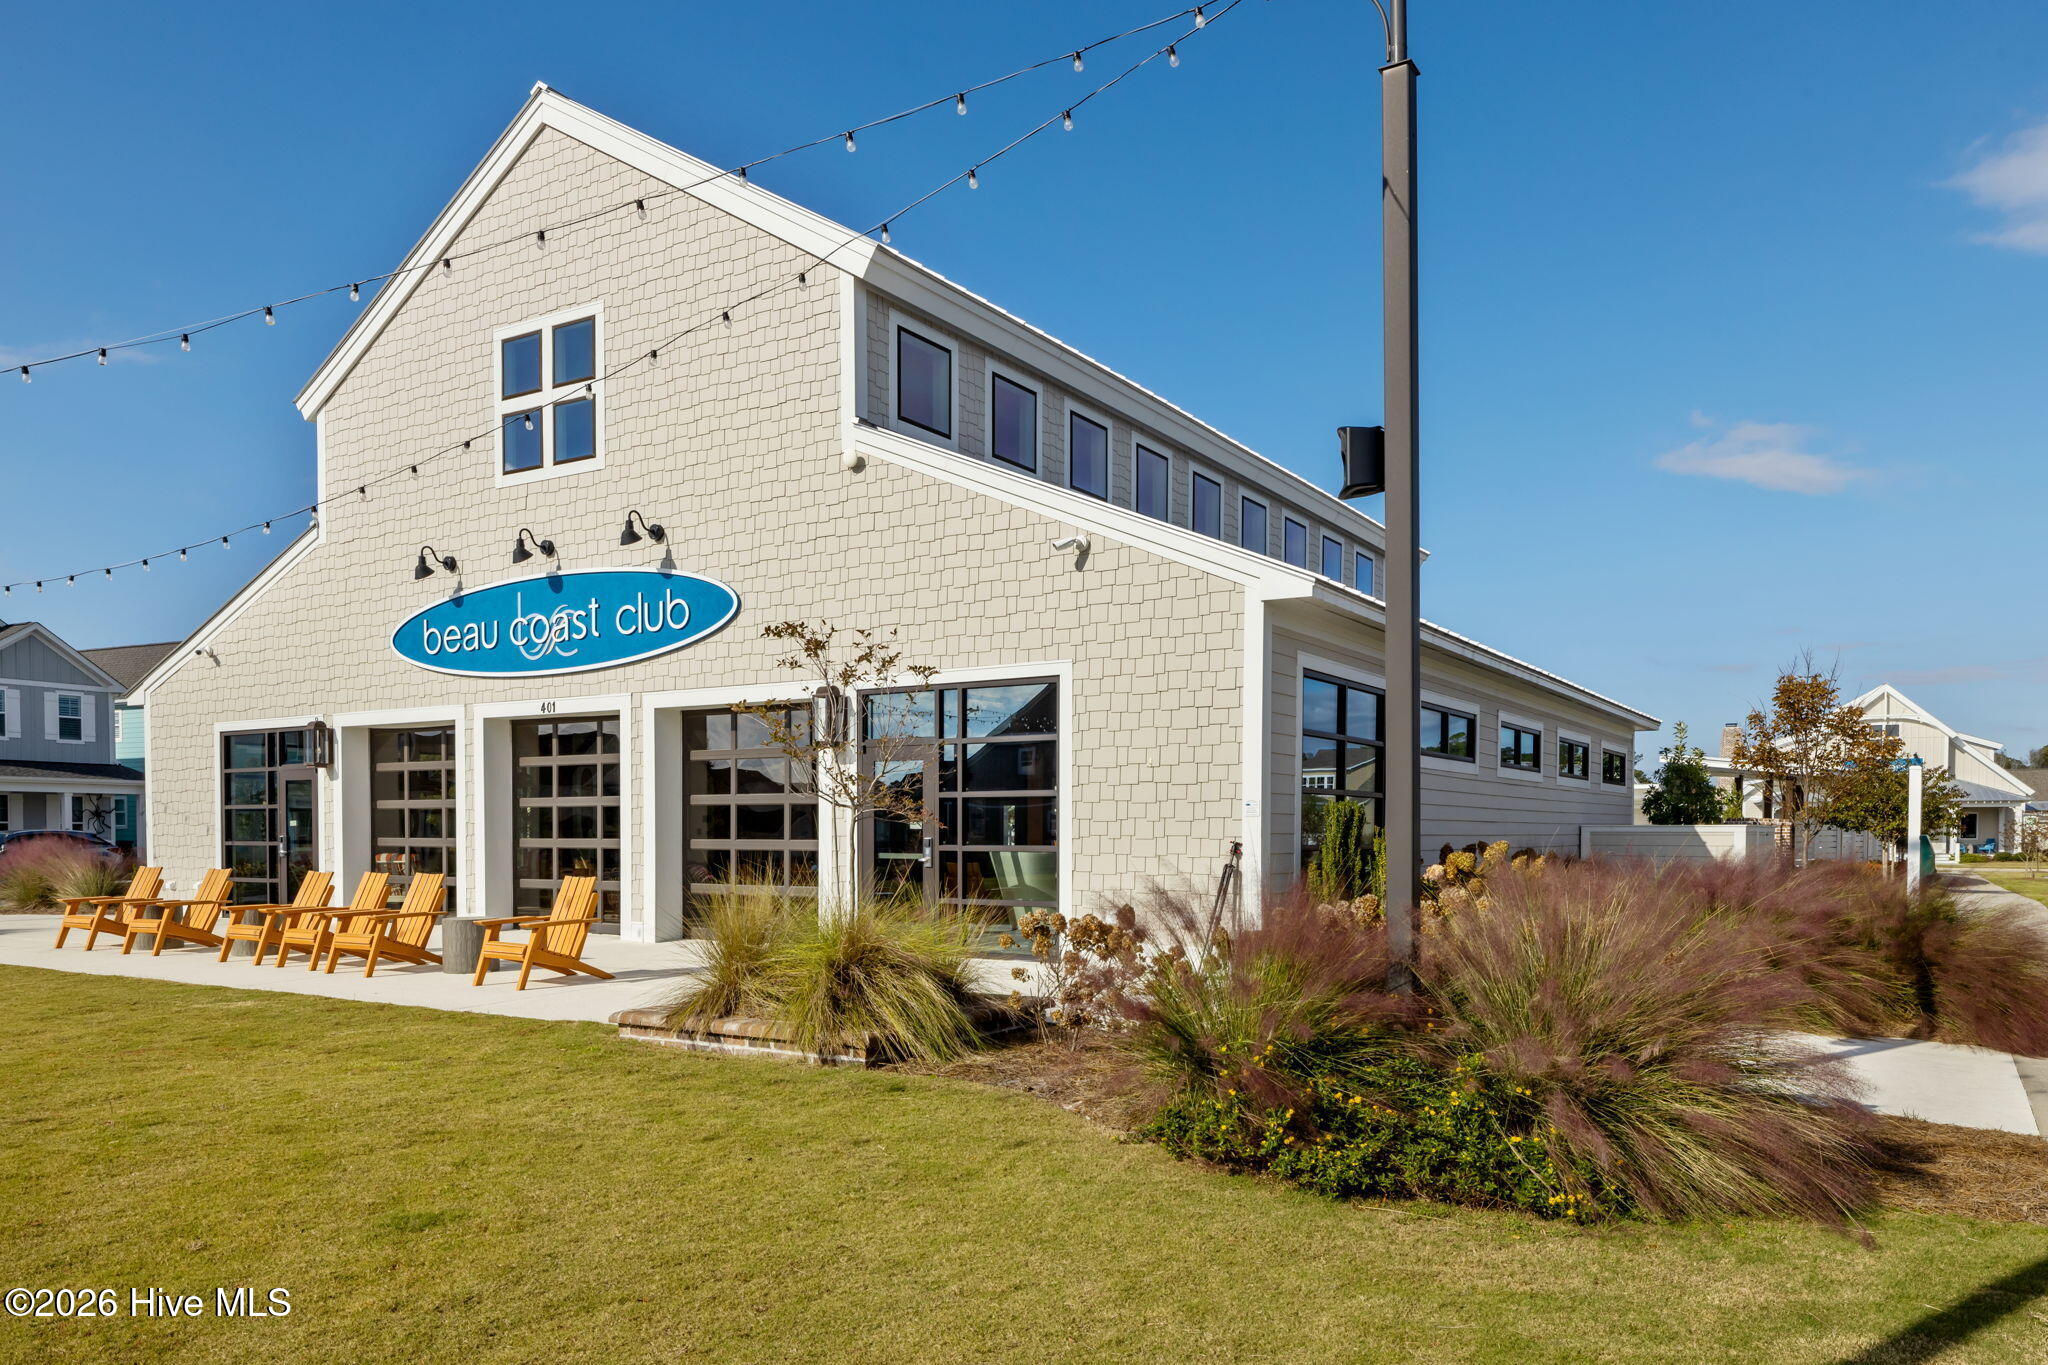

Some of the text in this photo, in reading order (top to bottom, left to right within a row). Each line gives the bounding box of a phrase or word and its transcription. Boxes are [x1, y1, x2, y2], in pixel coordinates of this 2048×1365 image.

[423, 588, 691, 655] beau coast club
[541, 701, 556, 714] 401
